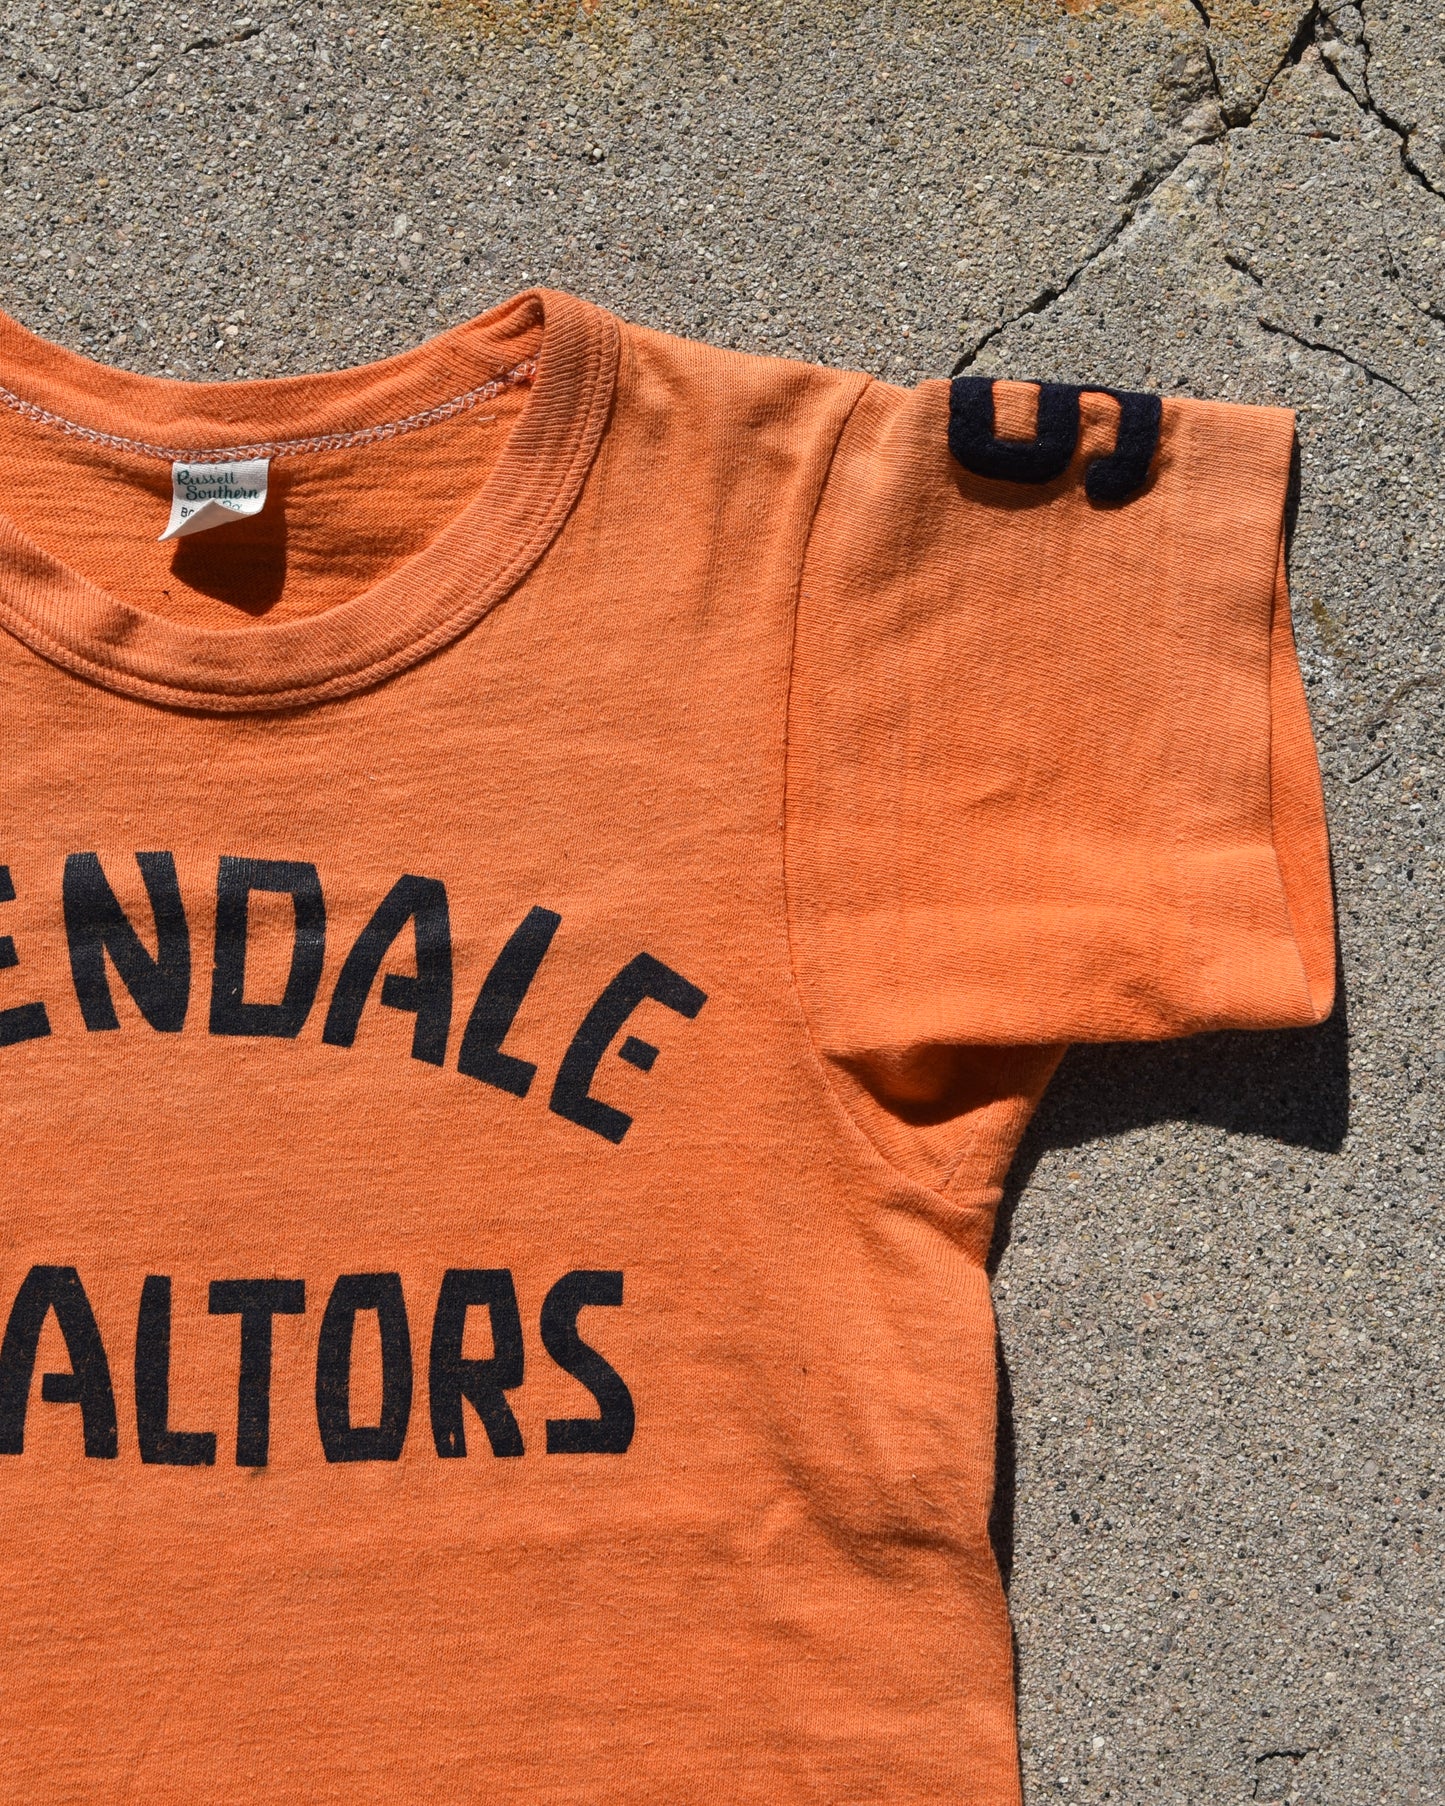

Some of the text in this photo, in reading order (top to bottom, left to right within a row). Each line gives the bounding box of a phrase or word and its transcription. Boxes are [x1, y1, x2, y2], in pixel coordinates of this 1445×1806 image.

[177, 470, 236, 486] Russell
[186, 486, 259, 501] Southern
[0, 1265, 636, 1467] ALTORS
